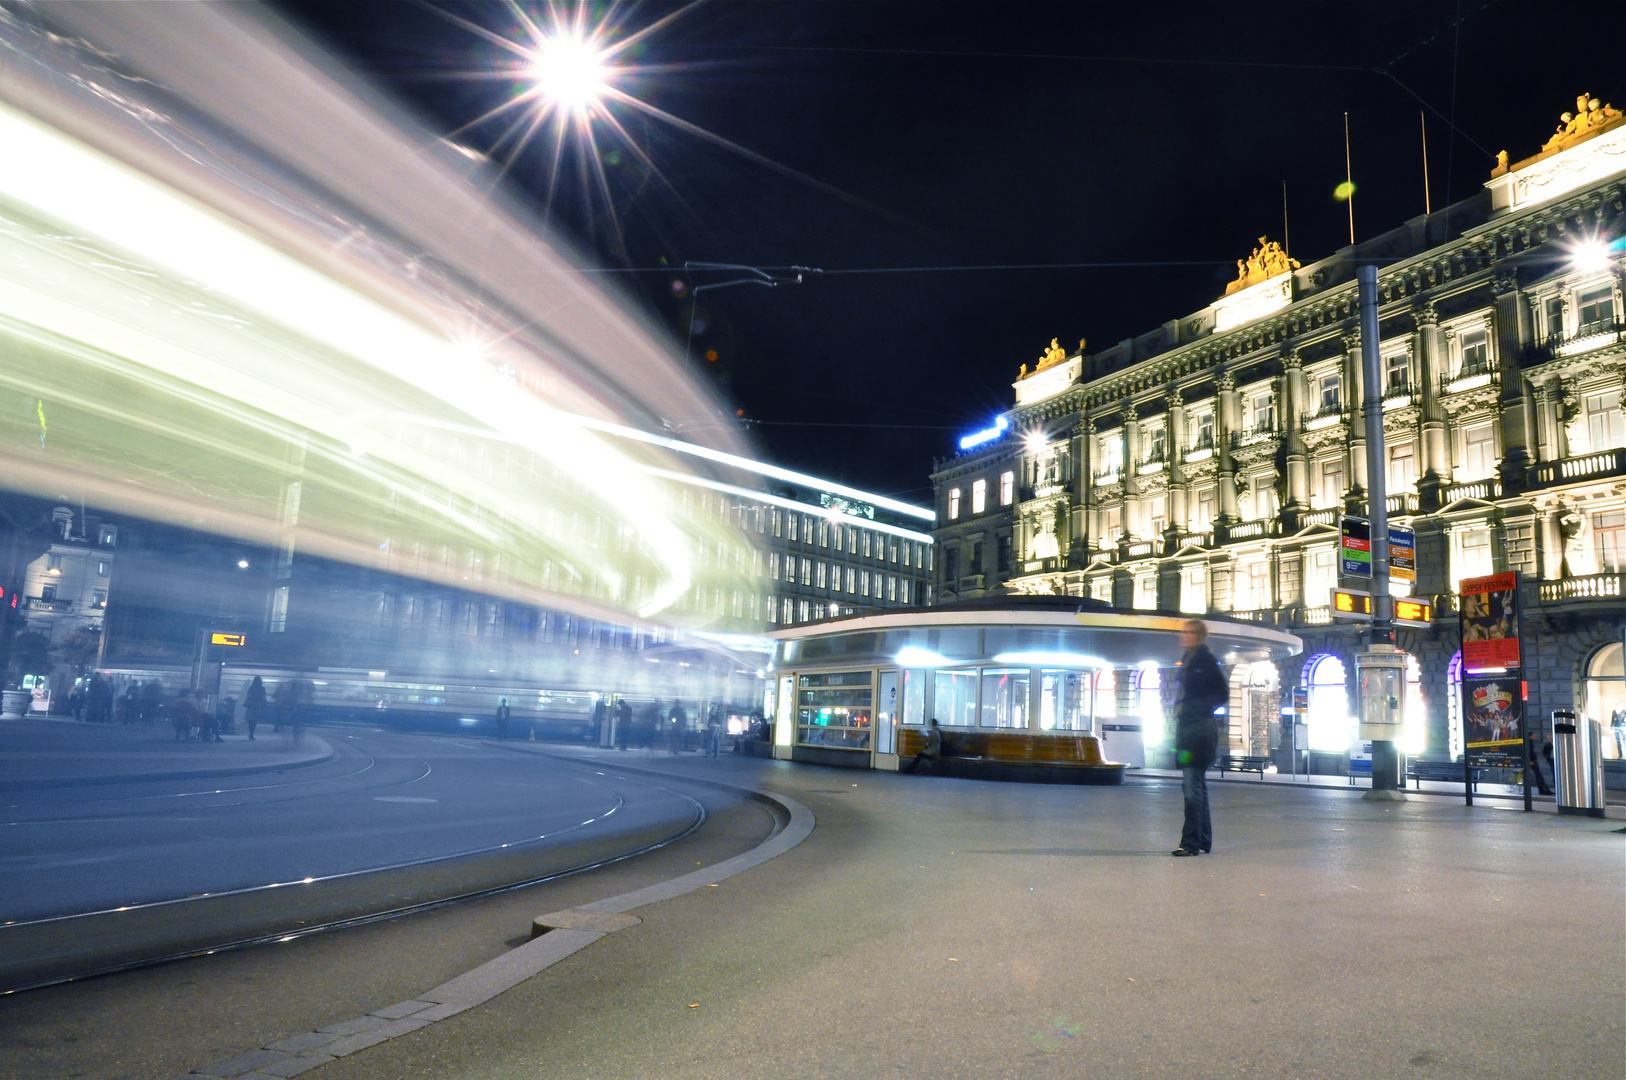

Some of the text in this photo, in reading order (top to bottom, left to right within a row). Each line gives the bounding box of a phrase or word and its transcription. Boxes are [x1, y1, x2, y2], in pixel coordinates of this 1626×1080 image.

[521, 370, 558, 396] UBS
[1346, 539, 1350, 547] 2
[1346, 561, 1351, 570] 9
[1462, 580, 1514, 593] GYPSY FESTIVAL
[828, 675, 844, 685] kiosk
